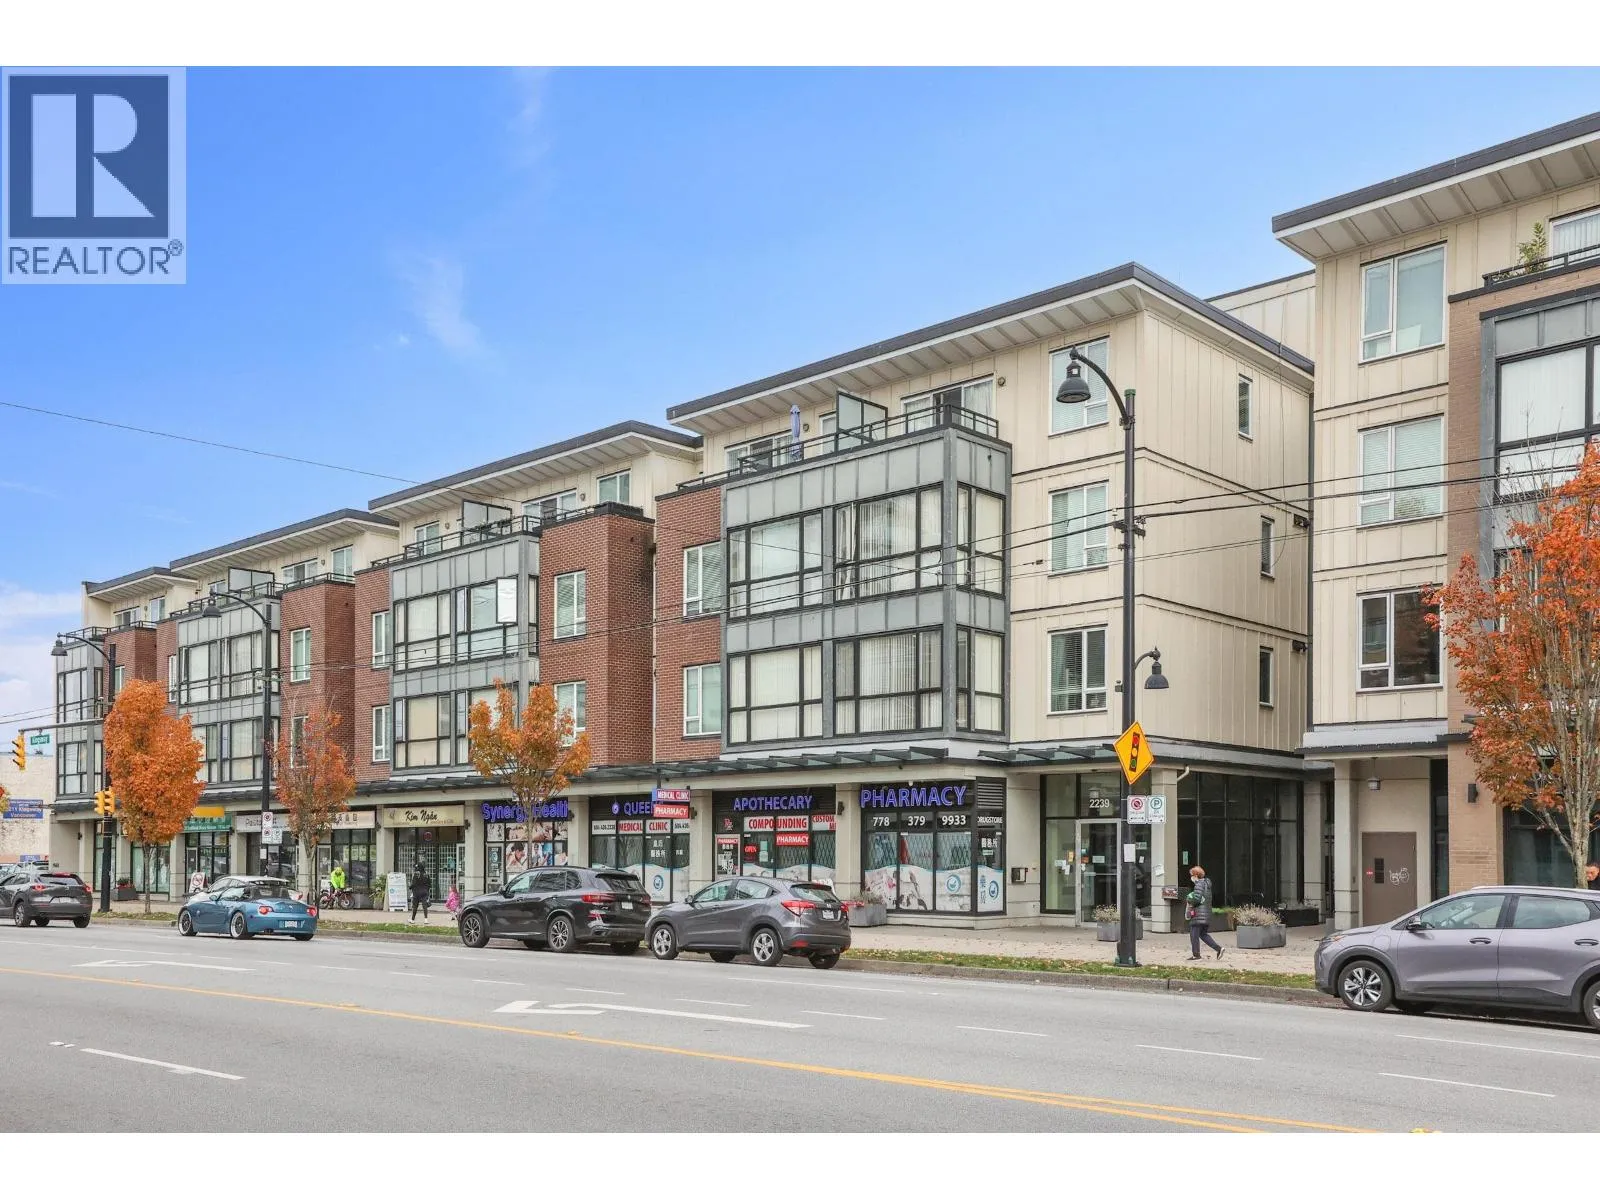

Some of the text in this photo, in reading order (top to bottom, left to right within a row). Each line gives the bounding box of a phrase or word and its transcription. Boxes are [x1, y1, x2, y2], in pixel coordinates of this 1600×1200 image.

[657, 791, 674, 799] MEDICAL
[860, 785, 967, 808] PHARMACY
[733, 795, 812, 811] APOTHECARY
[1089, 799, 1110, 808] 2239
[405, 810, 418, 821] Kim
[655, 806, 687, 815] PHARMACY
[873, 815, 967, 826] 778 379 9933
[617, 822, 643, 832] MEDICAL
[649, 821, 668, 831] CLINIC
[744, 845, 757, 853] OPEN
